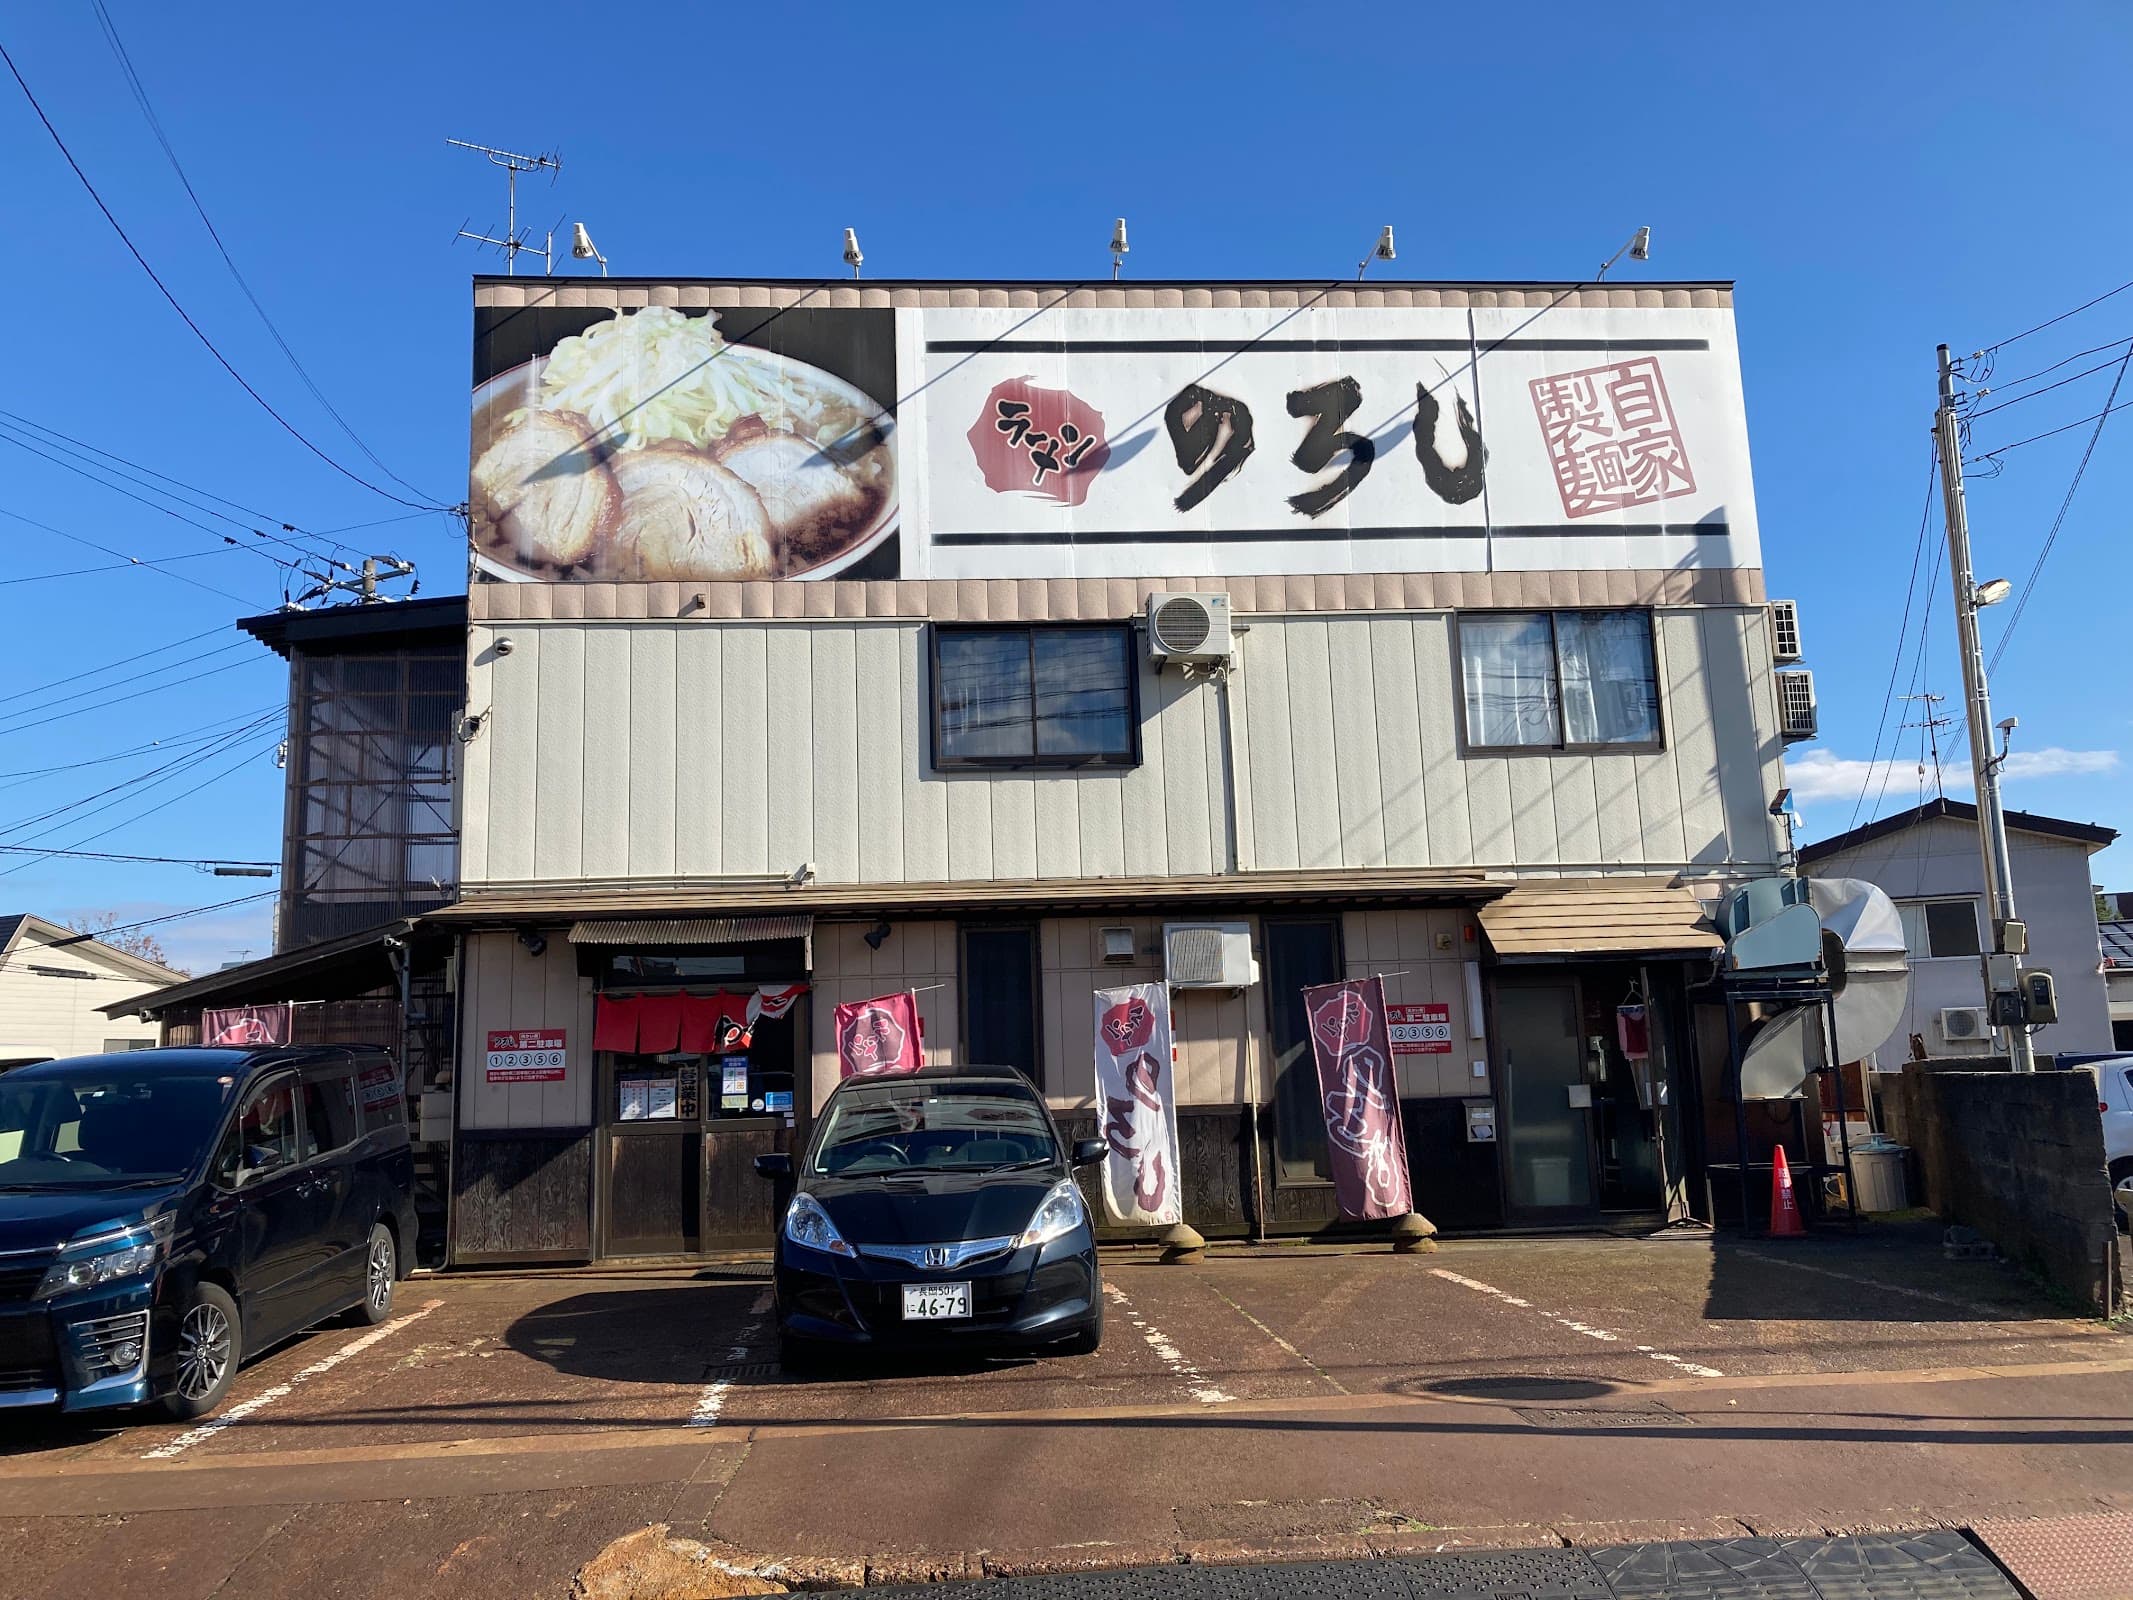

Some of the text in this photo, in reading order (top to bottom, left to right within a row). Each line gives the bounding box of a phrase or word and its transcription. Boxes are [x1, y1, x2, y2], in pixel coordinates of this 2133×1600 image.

[996, 399, 1096, 485] ラーメン
[1164, 358, 1488, 520] のろし
[1534, 375, 1636, 512] 製麺
[1604, 366, 1691, 497] 自家
[918, 1297, 967, 1316] 46-79
